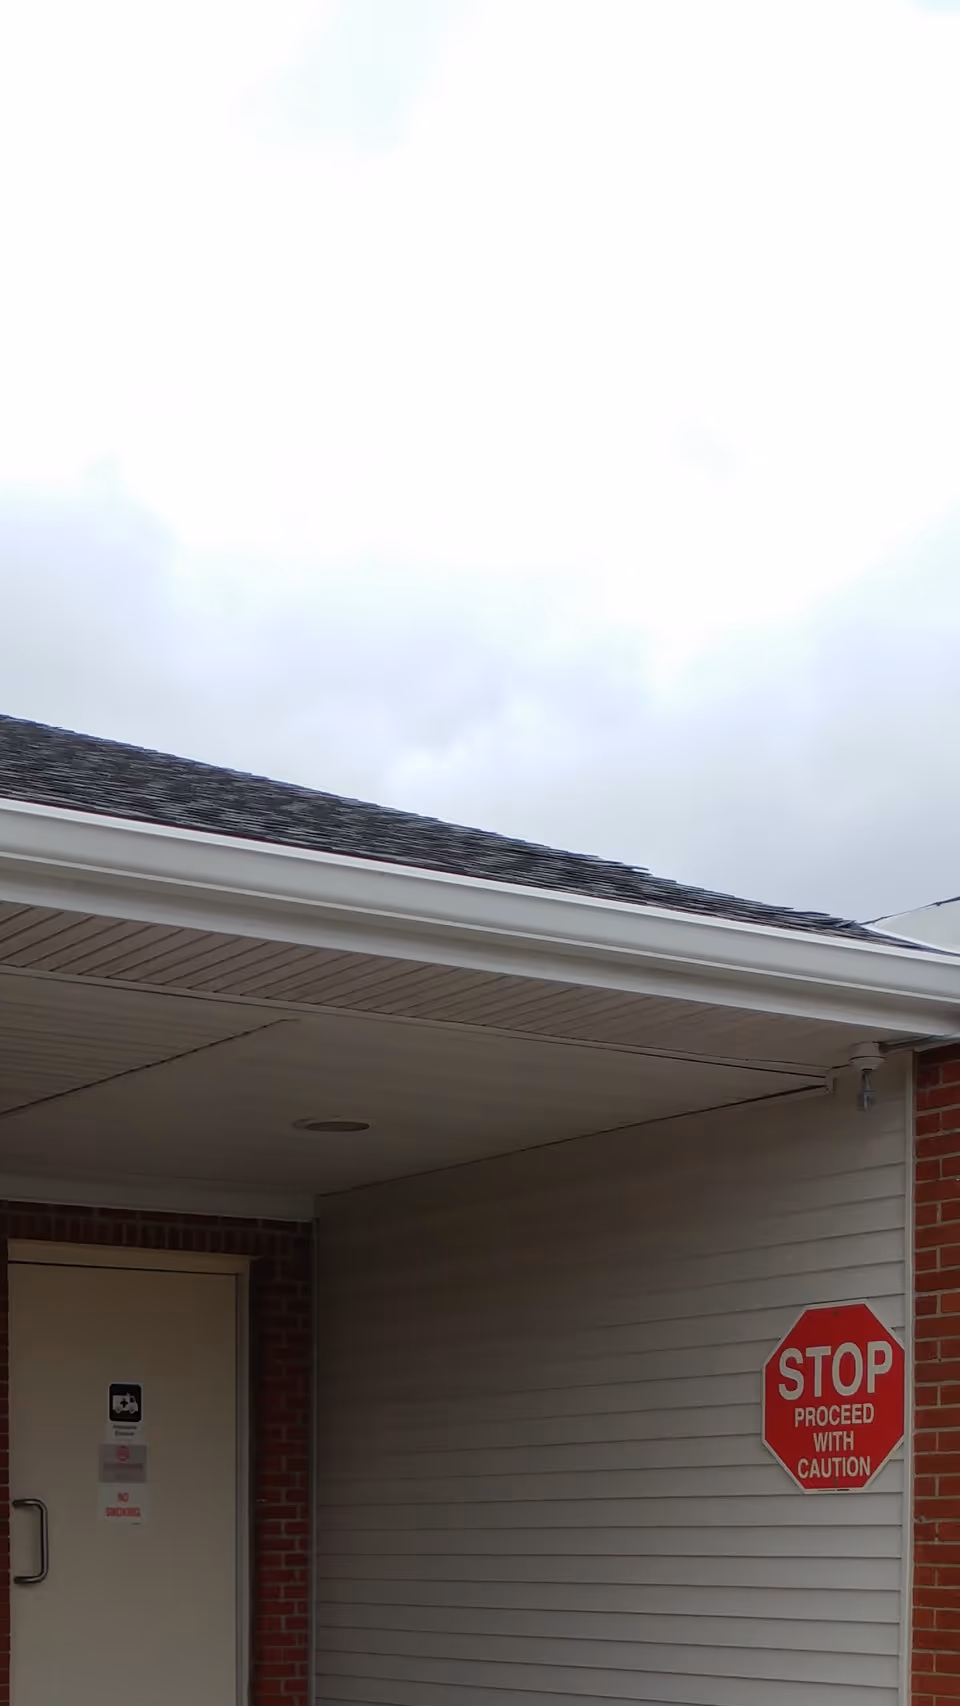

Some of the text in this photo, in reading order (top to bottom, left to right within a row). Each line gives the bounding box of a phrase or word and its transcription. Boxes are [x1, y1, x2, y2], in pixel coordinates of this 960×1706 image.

[778, 1340, 893, 1400] STOP
[794, 1403, 875, 1428] PROCEED
[813, 1430, 854, 1452] WITH
[797, 1456, 871, 1479] CAUTION
